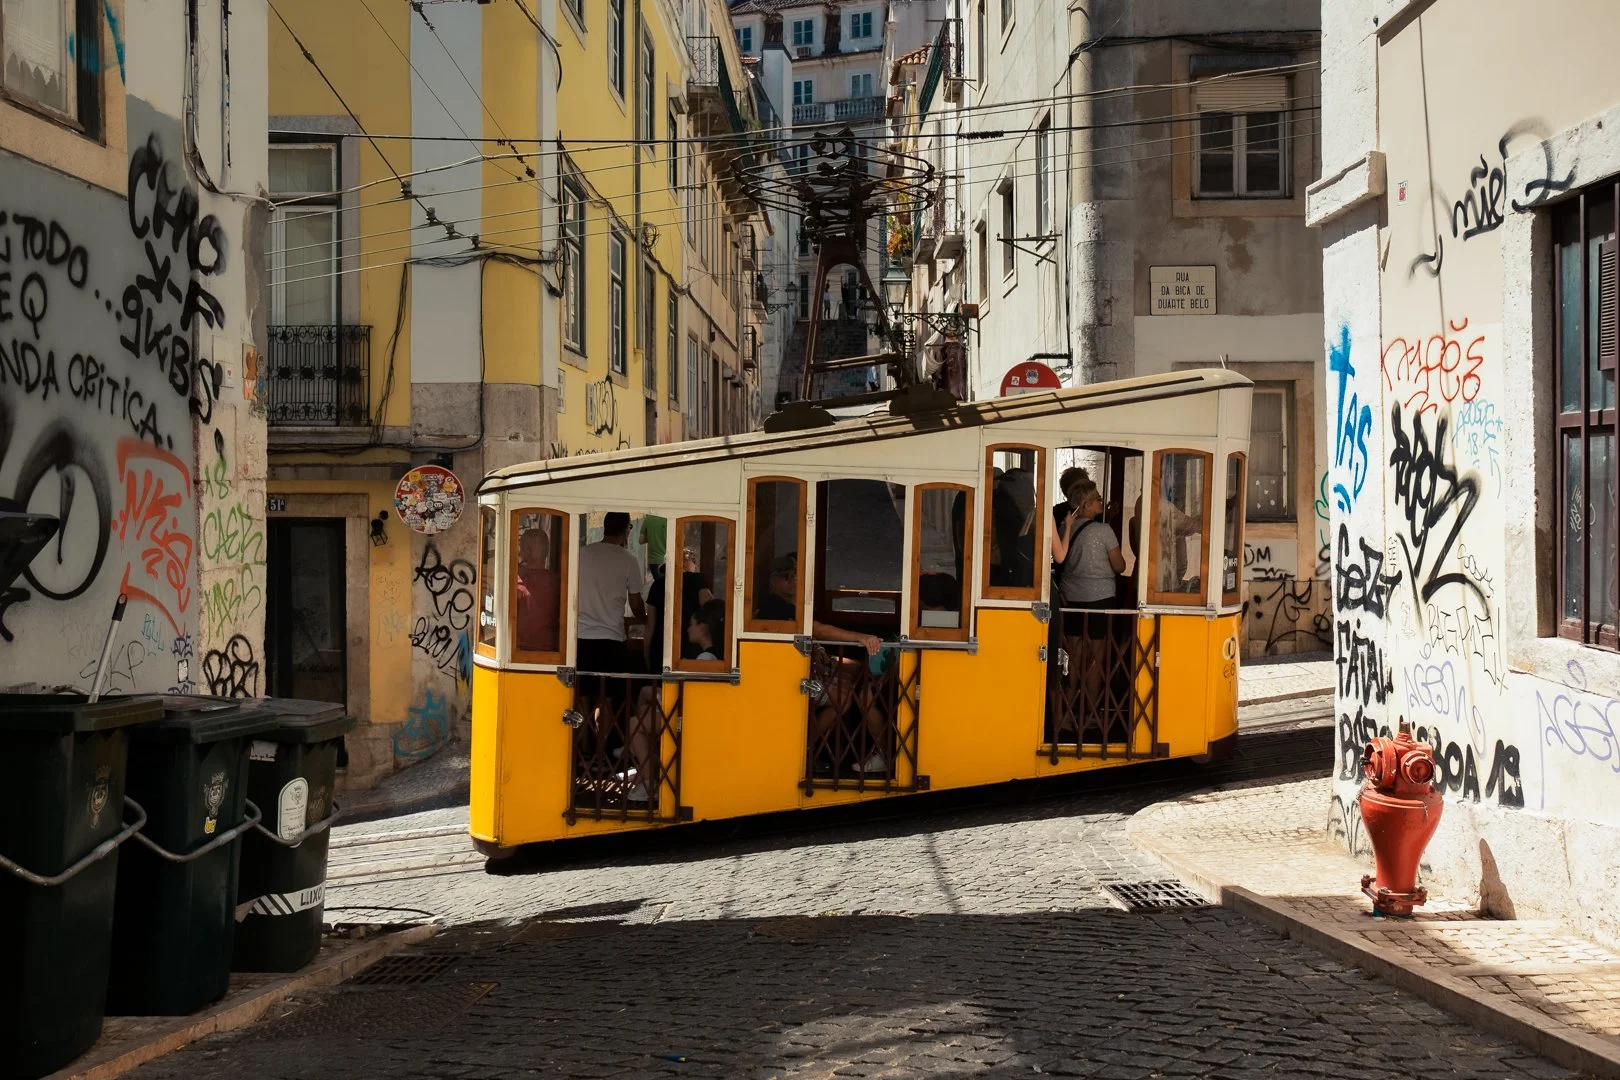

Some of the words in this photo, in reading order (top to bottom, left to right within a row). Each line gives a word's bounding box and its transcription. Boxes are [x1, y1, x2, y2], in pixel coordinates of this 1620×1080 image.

[1175, 272, 1190, 282] RUA
[1161, 286, 1170, 296] DA
[1175, 286, 1191, 296] BICA
[1195, 286, 1205, 296] DE
[1158, 299, 1185, 309] DUARTE
[1190, 299, 1209, 309] BELO
